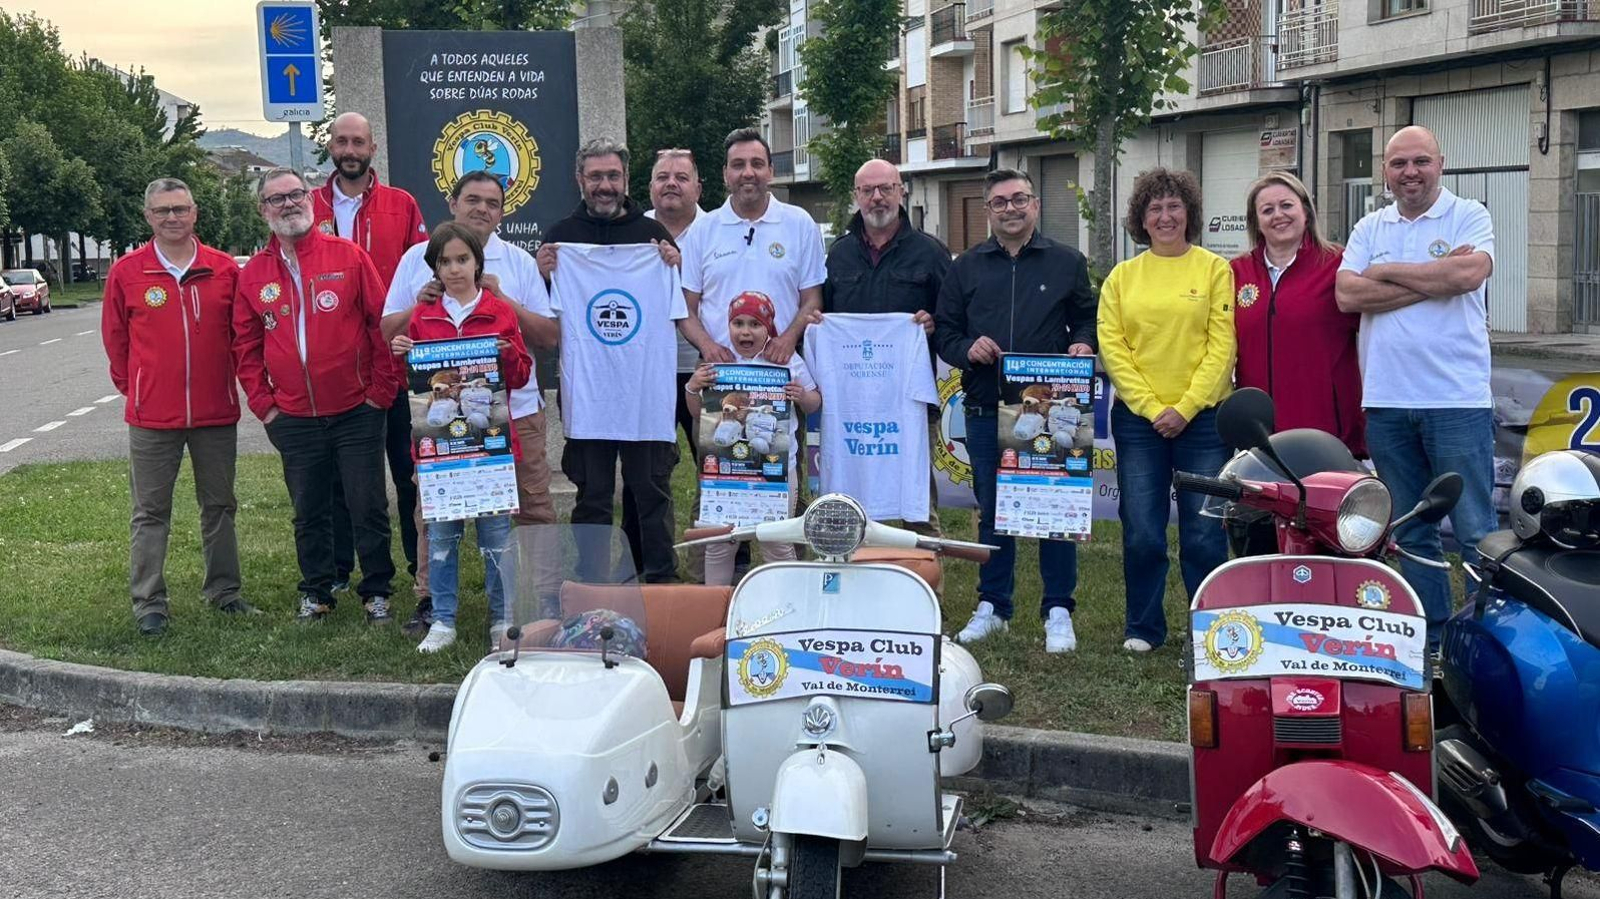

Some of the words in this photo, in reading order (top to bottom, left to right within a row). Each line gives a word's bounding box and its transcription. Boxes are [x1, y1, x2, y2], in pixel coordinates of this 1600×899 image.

[431, 54, 438, 66] A
[441, 54, 477, 65] TODOS
[481, 54, 529, 66] AQUELES
[420, 71, 443, 83] QUE
[448, 71, 504, 82] ENTENDEN
[508, 71, 515, 82] A
[520, 71, 545, 82] VIDA
[430, 88, 465, 99] SOBRE
[469, 86, 498, 99] DÚAS
[502, 88, 538, 99] RODAS
[276, 108, 310, 119] galicia
[447, 128, 471, 151] Vespa
[473, 122, 498, 130] Club
[506, 222, 542, 235] UNHA,
[430, 341, 496, 353] CONCENTRACIÓN
[432, 349, 494, 358] INTERNACIONAL
[412, 361, 441, 371] Vespas
[451, 357, 497, 367] Lambrettas
[1026, 360, 1090, 368] CONCENTRACIÓN
[725, 369, 786, 378] CONCENTRACIÓN
[1006, 375, 1034, 383] Vespas
[1044, 376, 1090, 384] Lambrettas
[843, 421, 899, 438] vespa
[844, 438, 898, 455] Verín
[949, 460, 960, 470] de
[1274, 612, 1352, 631] Vespa
[1358, 616, 1415, 638] Club
[798, 639, 864, 655] Vespa
[870, 639, 923, 656] Club
[1299, 633, 1397, 660] Verín
[819, 657, 905, 679] Verín
[1281, 660, 1306, 670] Val
[1311, 660, 1329, 671] de
[1333, 662, 1407, 681] Monterrei
[802, 681, 823, 690] Val
[829, 681, 843, 690] de
[846, 682, 916, 696] Monterrei
